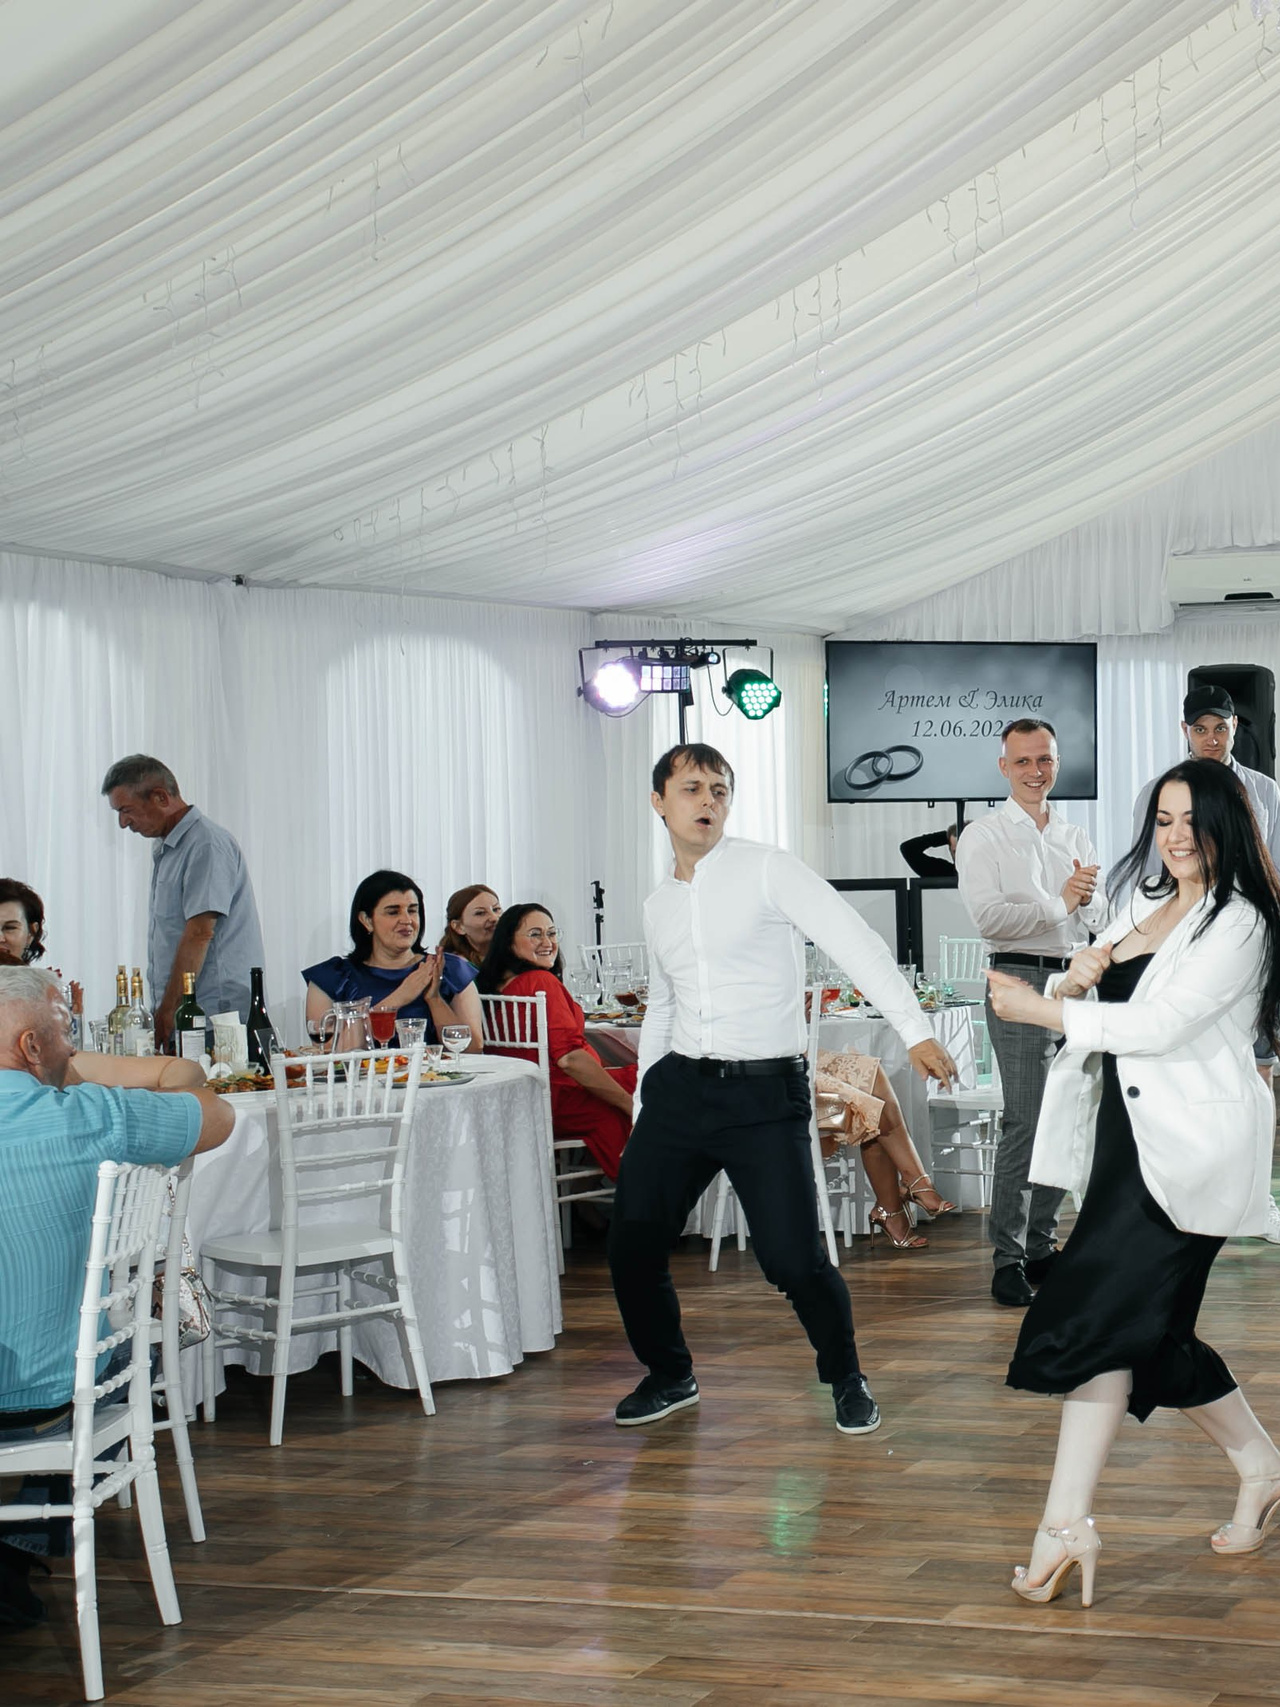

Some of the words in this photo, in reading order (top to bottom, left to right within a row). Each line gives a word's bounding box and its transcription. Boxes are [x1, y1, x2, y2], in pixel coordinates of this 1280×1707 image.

[877, 690, 951, 714] Артем
[958, 688, 979, 709] &
[983, 690, 1043, 712] Элика
[911, 719, 1014, 737] 12.06.202
